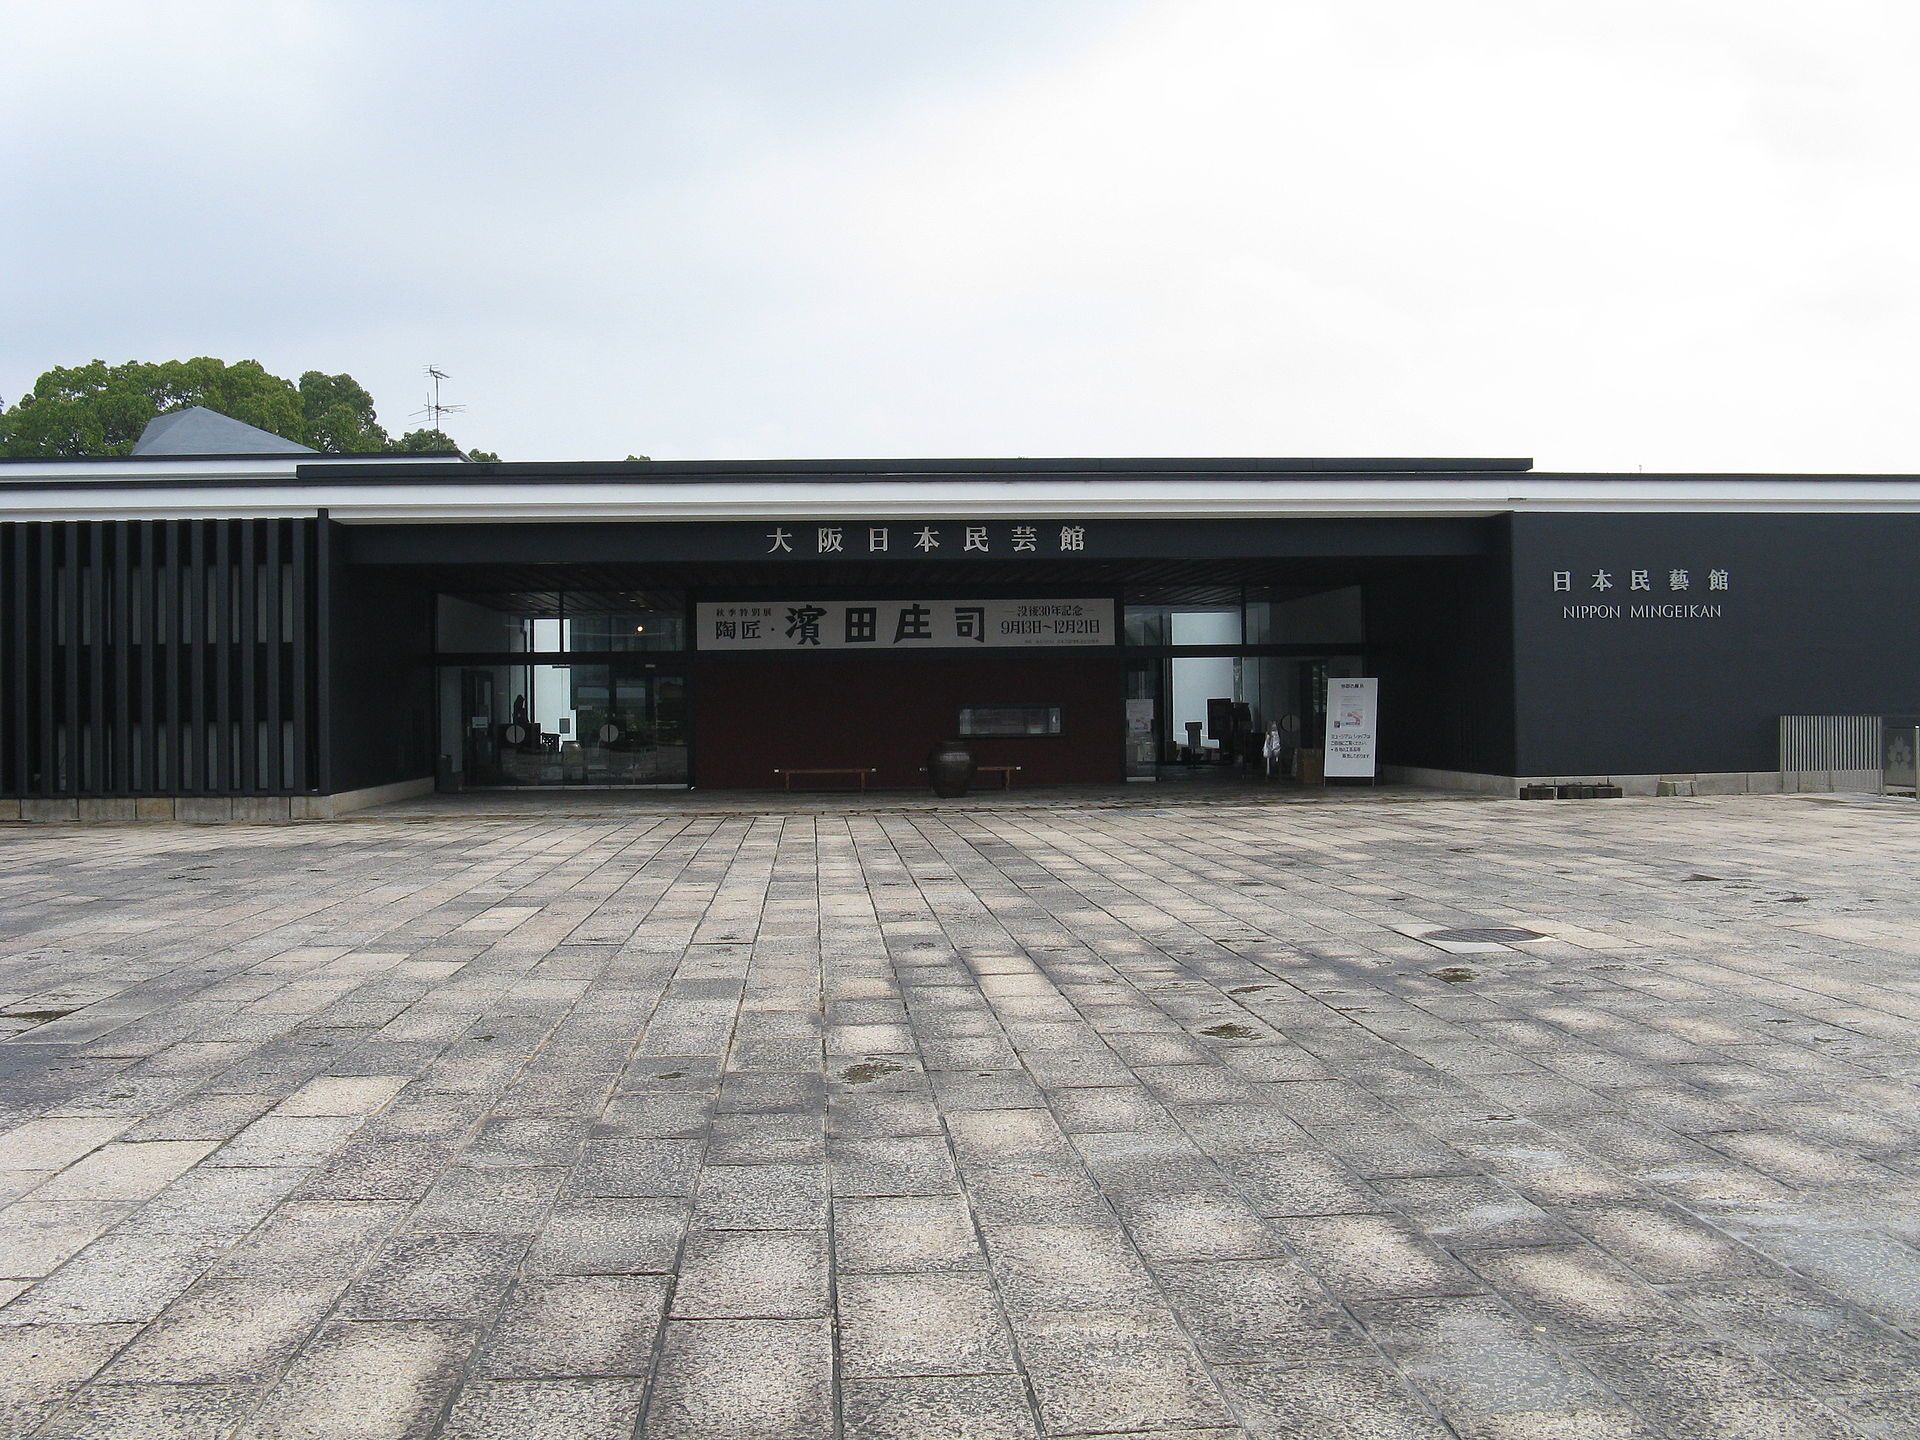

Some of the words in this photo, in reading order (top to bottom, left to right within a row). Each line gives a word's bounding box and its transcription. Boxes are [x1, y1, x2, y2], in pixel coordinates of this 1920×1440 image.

[766, 526, 1086, 554] 大阪日本民芸館
[1553, 568, 1729, 592] 日本民藝館
[1563, 605, 1621, 619] NIPPON
[1630, 604, 1722, 618] MINGEIKAN
